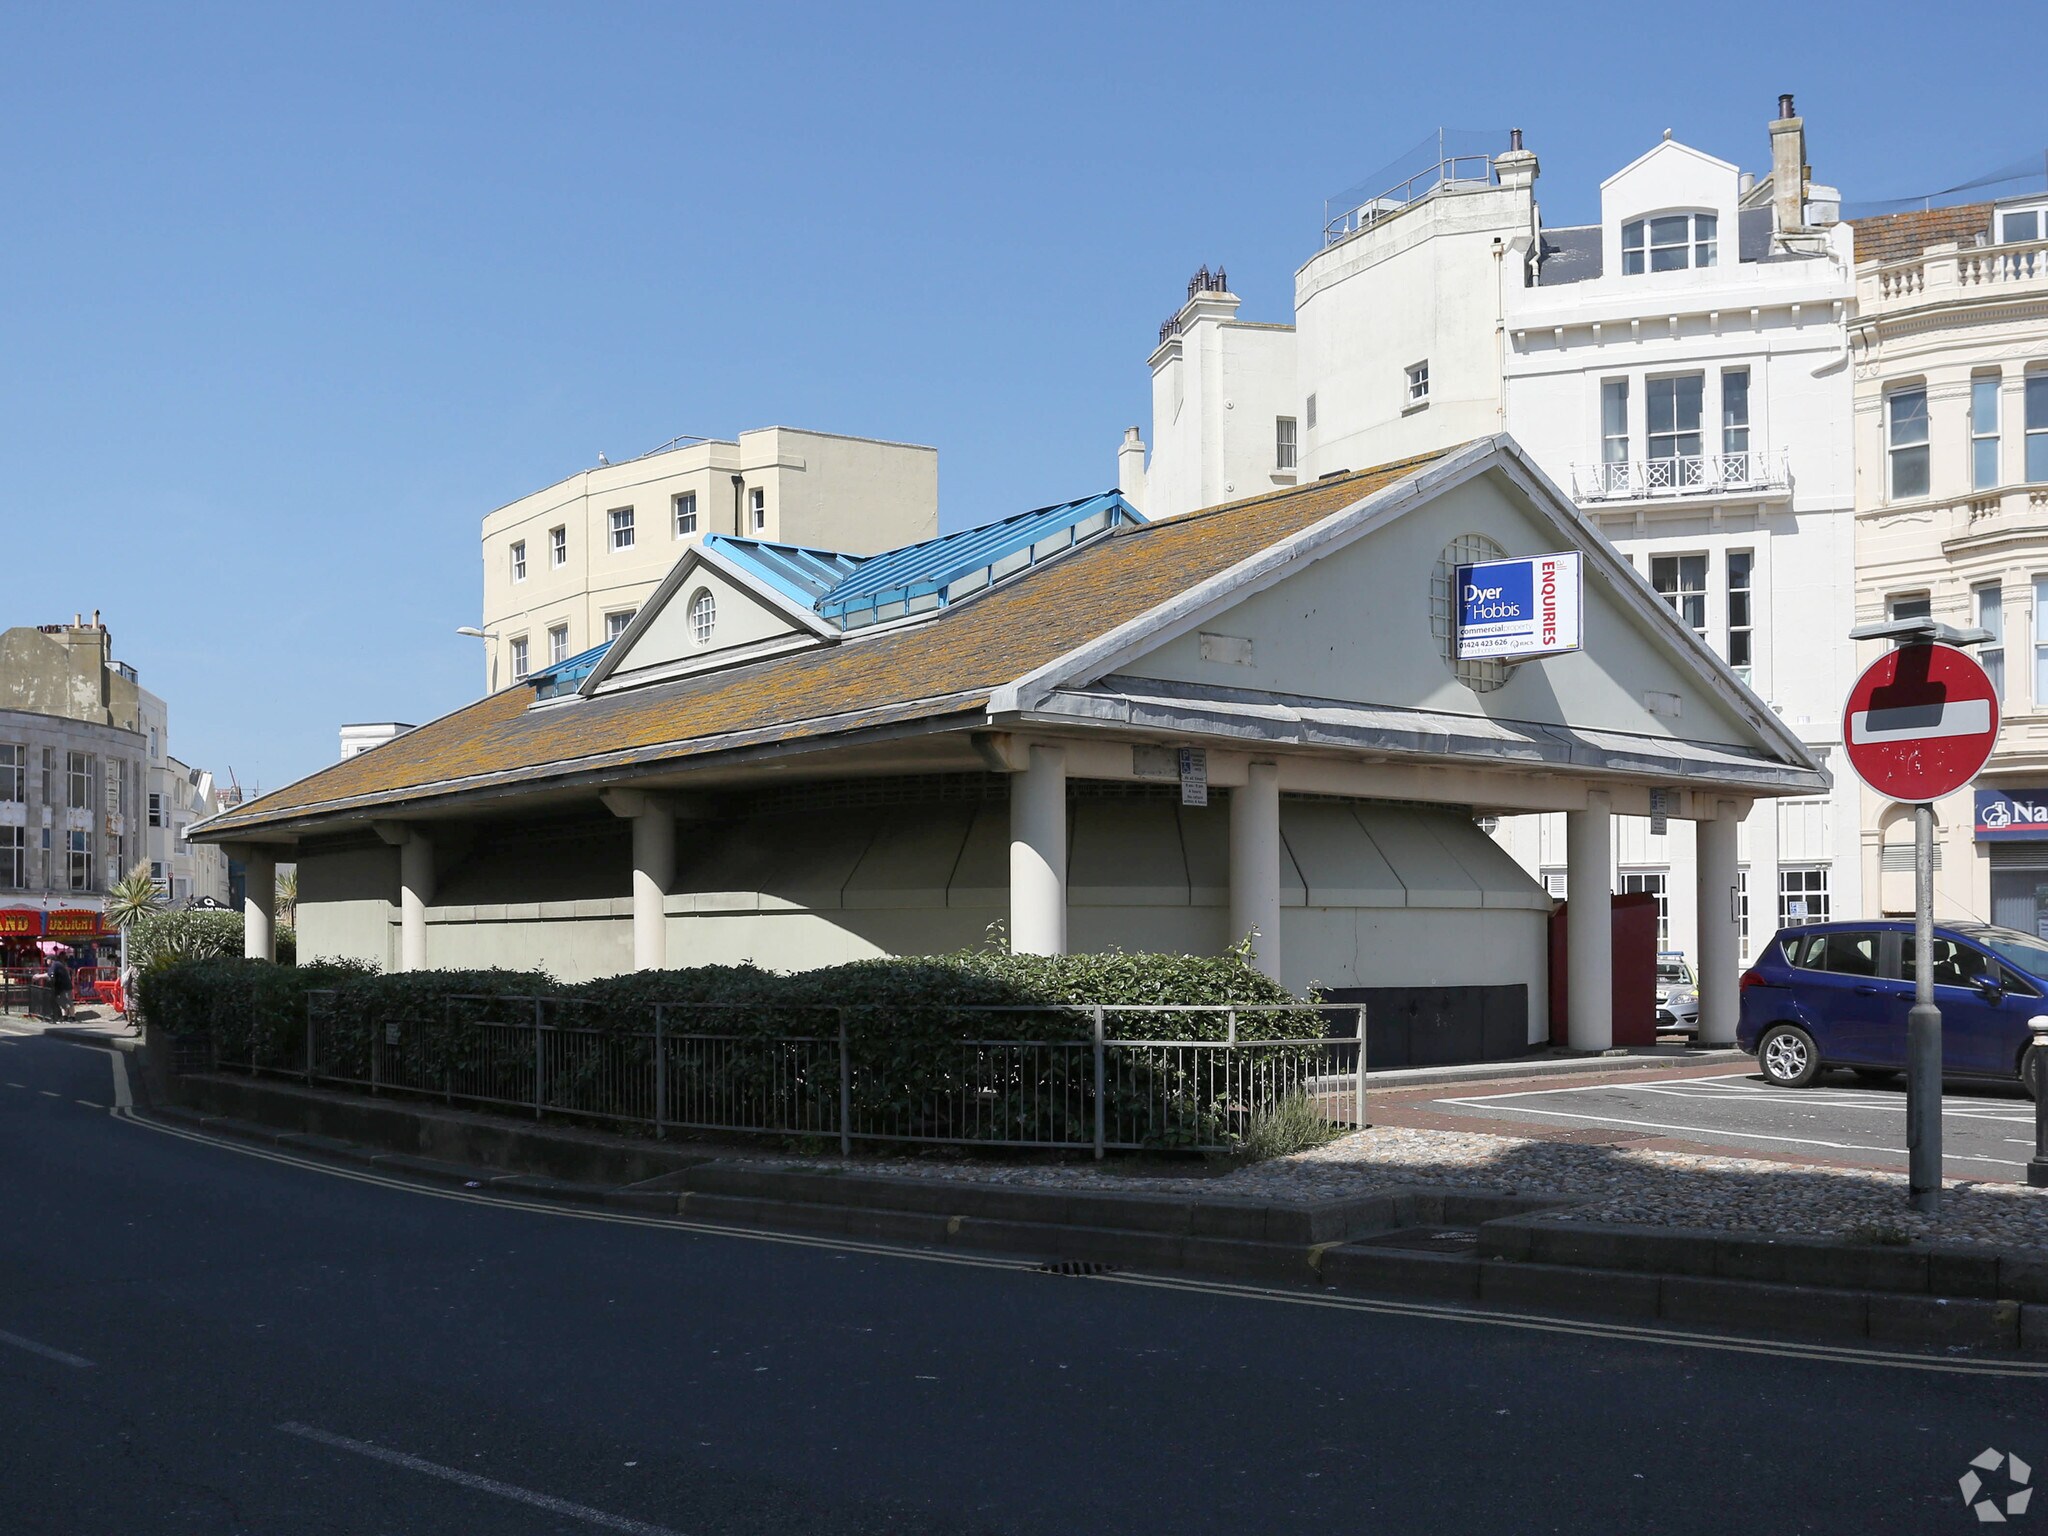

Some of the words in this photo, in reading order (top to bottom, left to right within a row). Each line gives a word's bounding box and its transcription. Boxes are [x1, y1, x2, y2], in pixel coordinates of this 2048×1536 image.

[1464, 584, 1503, 605] Dyer
[1541, 561, 1556, 646] ENQUIRIES
[1473, 602, 1520, 620] Hobbis
[1459, 639, 1480, 649] 01424
[1480, 639, 1494, 648] 423
[1494, 638, 1508, 647] 626
[48, 915, 94, 931] DELIGHT
